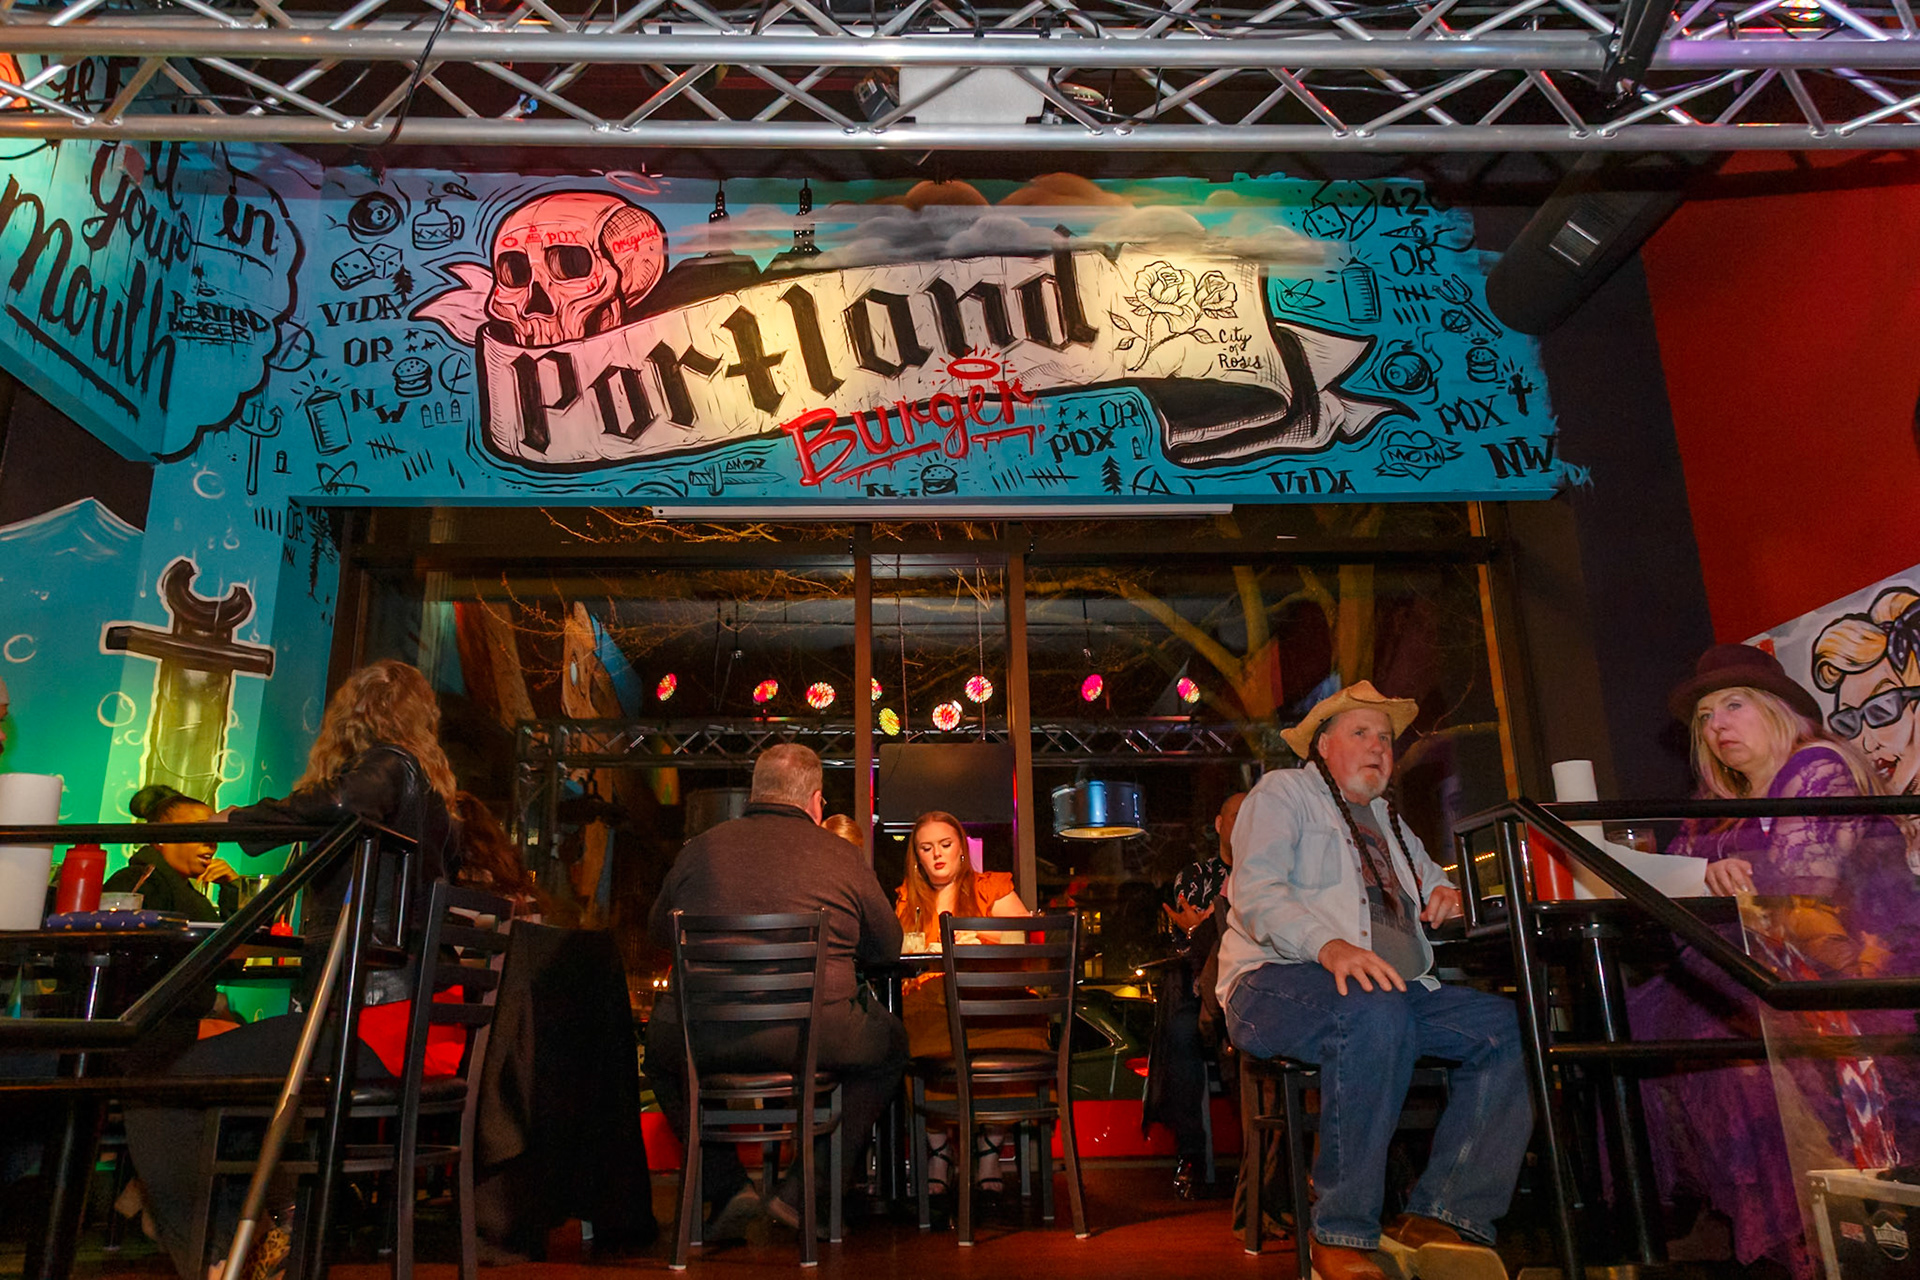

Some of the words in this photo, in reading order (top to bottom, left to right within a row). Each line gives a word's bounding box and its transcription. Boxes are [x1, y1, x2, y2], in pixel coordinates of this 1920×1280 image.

[214, 184, 278, 255] in
[544, 230, 583, 244] PDX
[1390, 242, 1441, 277] OR
[343, 337, 396, 367] OR
[511, 225, 1101, 455] Portland
[1218, 327, 1253, 350] City
[1098, 400, 1142, 429] OR
[1434, 394, 1510, 435] PDX
[1044, 426, 1117, 464] PDX
[1387, 449, 1443, 463] MOM
[1481, 434, 1559, 480] NW
[287, 506, 306, 543] OR
